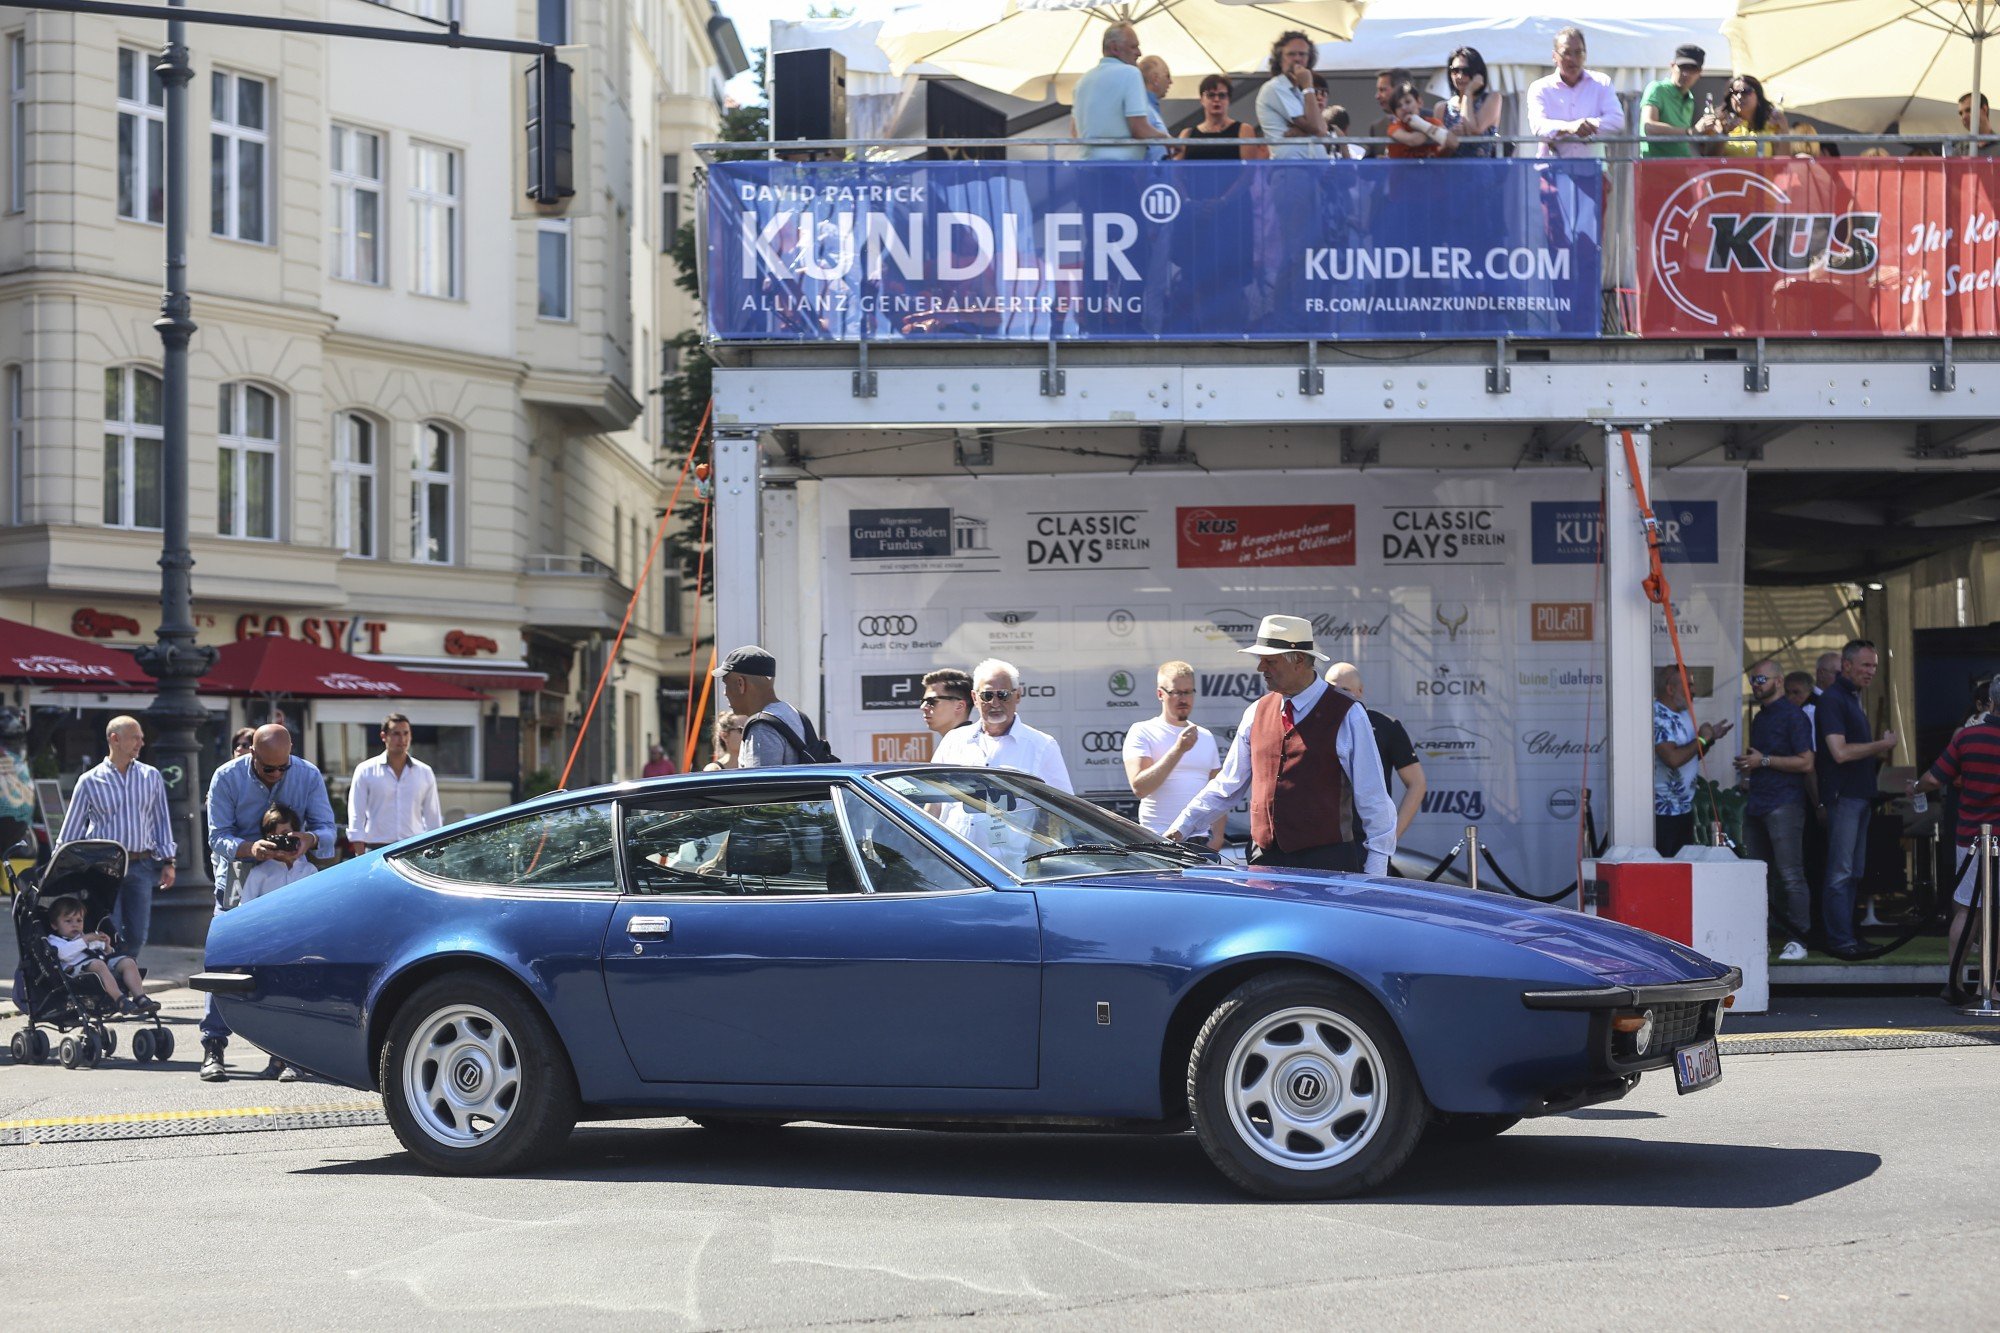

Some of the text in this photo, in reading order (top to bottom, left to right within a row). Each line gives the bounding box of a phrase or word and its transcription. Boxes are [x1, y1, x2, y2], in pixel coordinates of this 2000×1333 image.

[741, 185, 925, 202] DAVID PATRICK
[742, 211, 1142, 281] KUNDLER
[1705, 213, 1881, 273] KUS
[1907, 221, 1953, 256] Ihr
[1305, 247, 1571, 281] KUNDLER.COM
[1901, 275, 1930, 305] in
[742, 294, 1142, 313] ALLIANZ GENERALVERTRETUNG
[1305, 297, 1571, 314] FB.COM/ALLIANZKUNDLERBERLIN
[854, 527, 947, 540] Grund & Boden
[1037, 515, 1137, 537] CLASSIC
[1196, 520, 1237, 534] KUS
[1393, 510, 1492, 531] CLASSIC
[879, 539, 924, 551] Fundus
[1218, 522, 1331, 552] Ihr Kompetenzteam
[1254, 544, 1294, 561] Sachen
[1298, 529, 1353, 551] Oldtimer!
[1383, 533, 1505, 559] DAYS BERLIN
[1028, 538, 1150, 565] DAYS BERLIN
[235, 613, 290, 641] GO
[989, 631, 1034, 640] BENTLEY
[1310, 613, 1390, 641] Chopard
[861, 640, 942, 651] Audi City Berlin
[1201, 673, 1263, 702] VILSA
[1416, 681, 1486, 696] ROCIM
[1519, 672, 1548, 685] wine
[1559, 668, 1603, 685] waters
[1522, 731, 1606, 759] Chopard
[1085, 757, 1108, 765] Audi
[1420, 790, 1485, 820] VILSA
[1685, 1055, 1695, 1083] B
